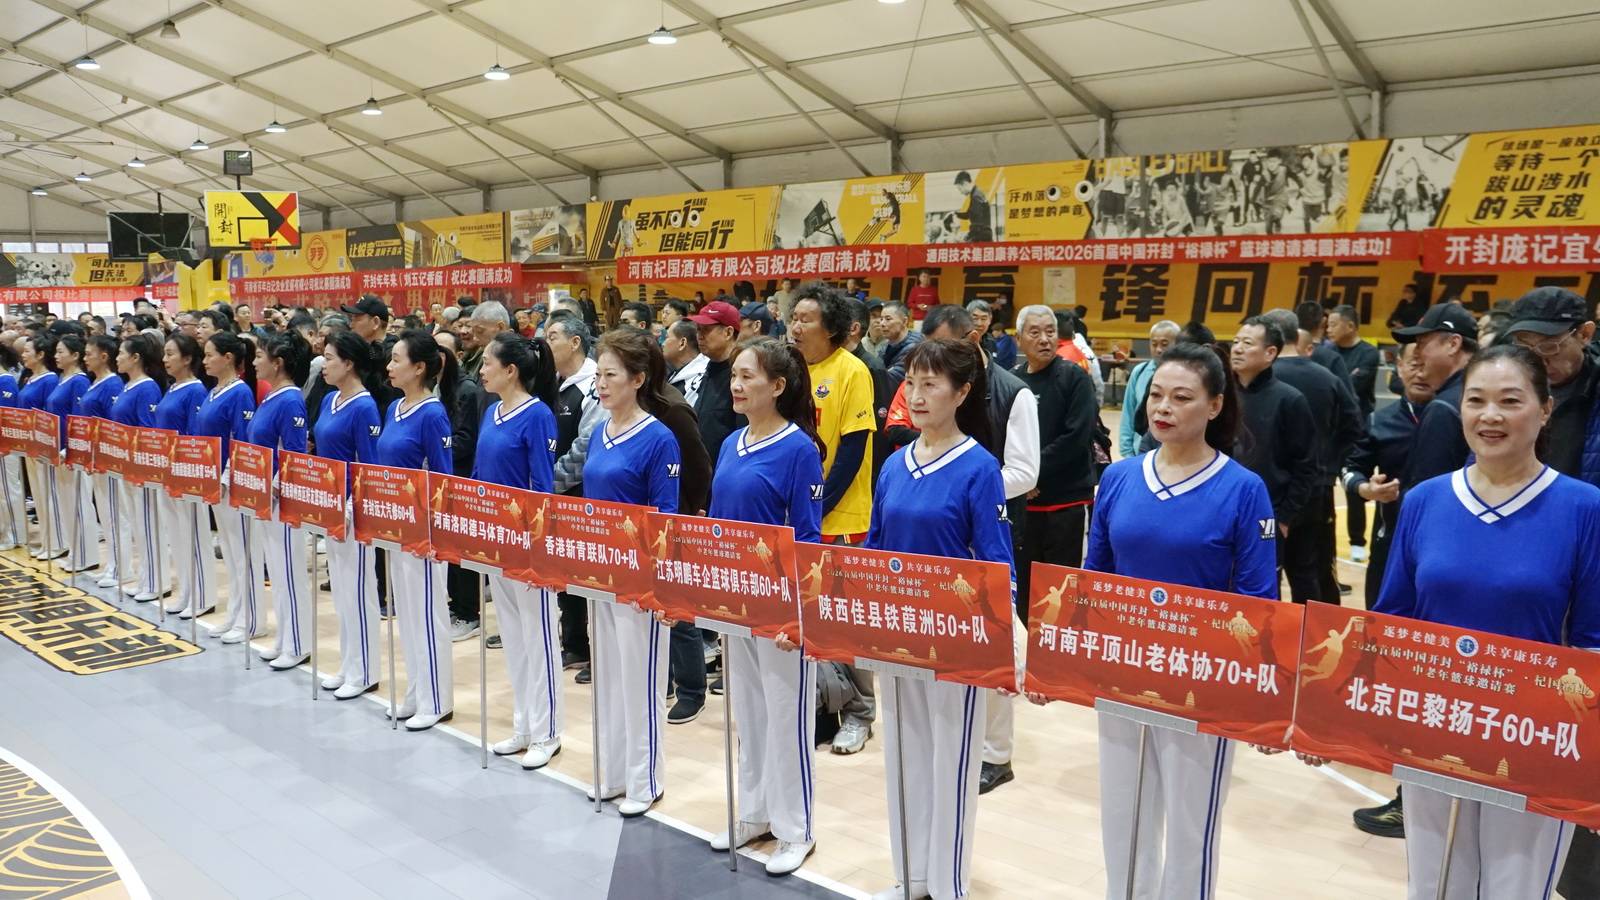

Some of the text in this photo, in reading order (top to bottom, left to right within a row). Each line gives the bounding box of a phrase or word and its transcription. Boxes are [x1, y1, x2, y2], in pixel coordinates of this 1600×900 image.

[1494, 149, 1600, 171] 等待一个
[1484, 171, 1591, 193] 跋山涉水
[1009, 205, 1083, 219] 是梦想的声音
[1474, 193, 1584, 220] 的灵魂
[659, 220, 734, 253] 但能同行
[1445, 233, 1600, 265] 开封庞记宜
[628, 250, 890, 279] 河南杞国酒业有限公司祝比赛圆满成功
[433, 511, 531, 550] 河南洛阳德马体育70+队
[544, 535, 640, 571] 香港新青联队70+队
[656, 559, 792, 603] 江苏明鹏车企篮球俱乐部60+队
[1093, 581, 1230, 613] 逐梦老健美 共享康乐寿
[817, 595, 990, 646] 陕西佳县铁葭洲50+队
[1117, 615, 1199, 638] 中老年篮球邀请赛
[1039, 622, 1279, 696] 河南平顶山老体协70+队
[1383, 625, 1559, 668] 逐梦老健美 共享康乐寿
[1412, 665, 1517, 696] 中老年篮球邀请赛
[1345, 677, 1581, 762] 北京巴黎扬子60+队
